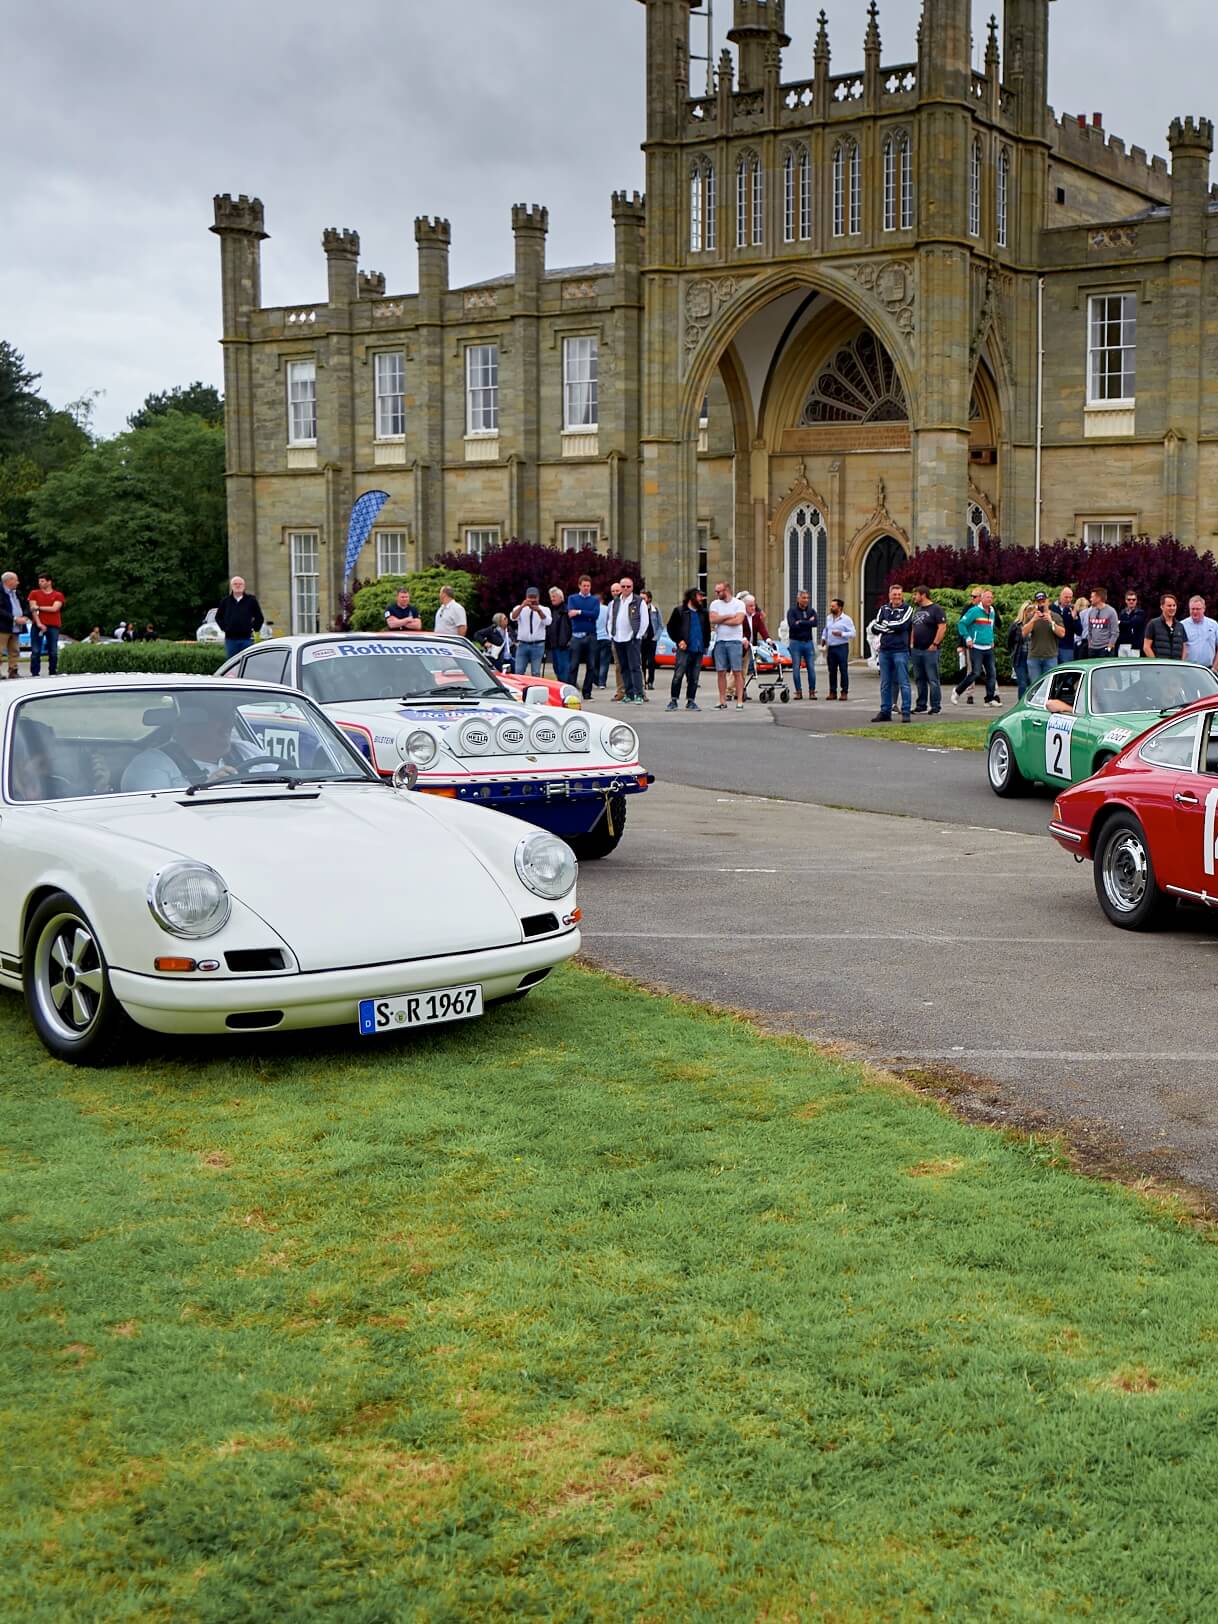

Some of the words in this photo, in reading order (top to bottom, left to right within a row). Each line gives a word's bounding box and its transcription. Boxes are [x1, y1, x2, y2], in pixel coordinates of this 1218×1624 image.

[337, 644, 453, 656] Rothmans
[468, 733, 488, 743] HELLA
[505, 731, 524, 742] HELLA
[1053, 733, 1064, 774] 2
[426, 989, 477, 1020] 1967
